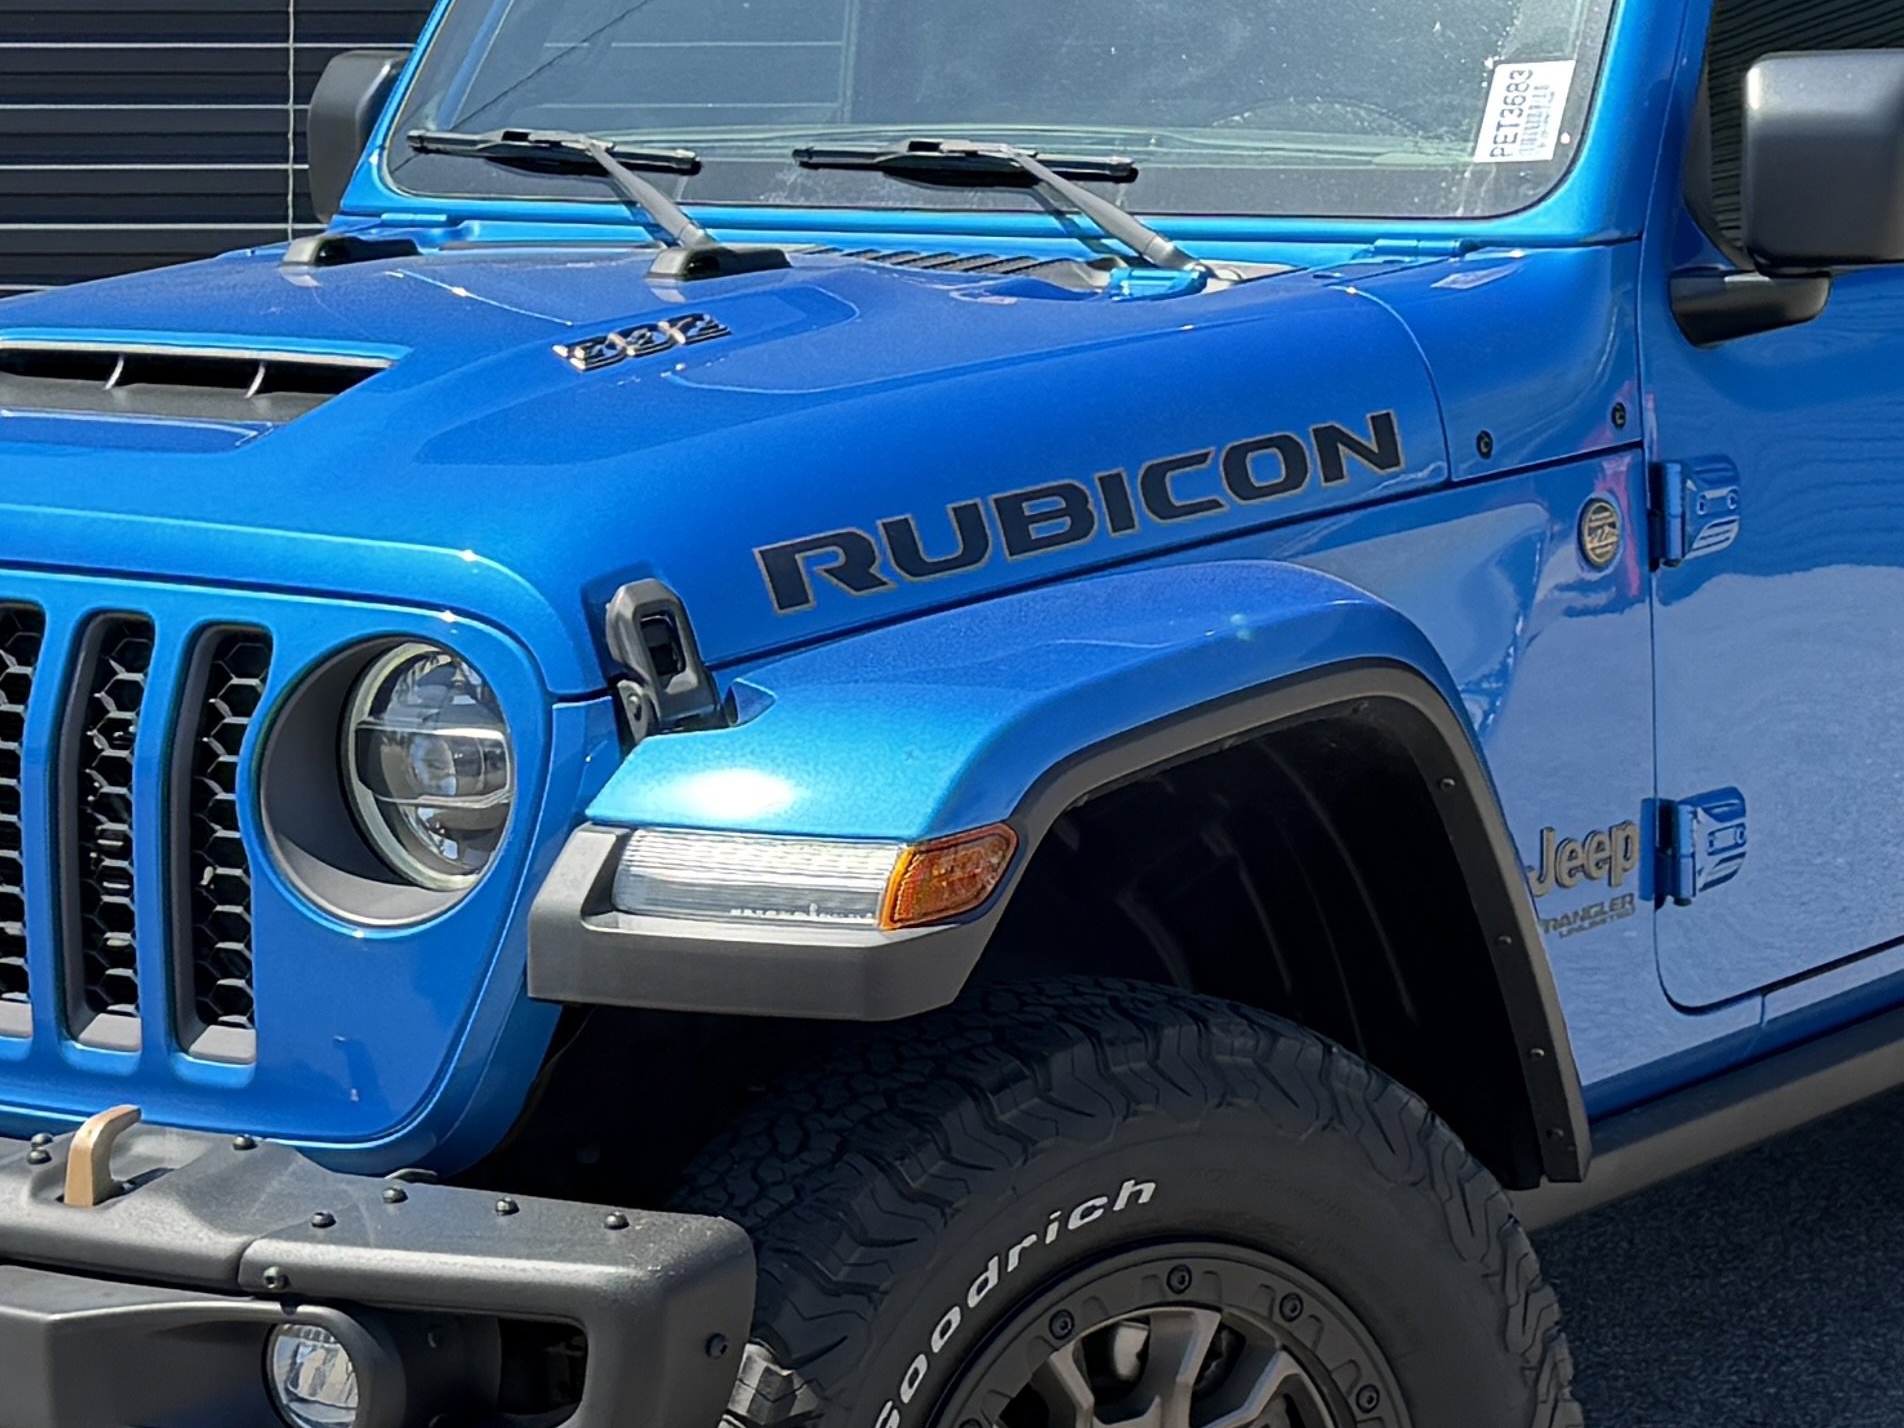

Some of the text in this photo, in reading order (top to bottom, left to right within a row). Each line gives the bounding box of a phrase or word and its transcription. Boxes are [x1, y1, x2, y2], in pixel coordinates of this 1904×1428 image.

[1490, 70, 1533, 157] PET3683
[754, 410, 1405, 614] RUBICON
[1525, 820, 1641, 897] Jeep
[1540, 892, 1635, 934] RANGLER
